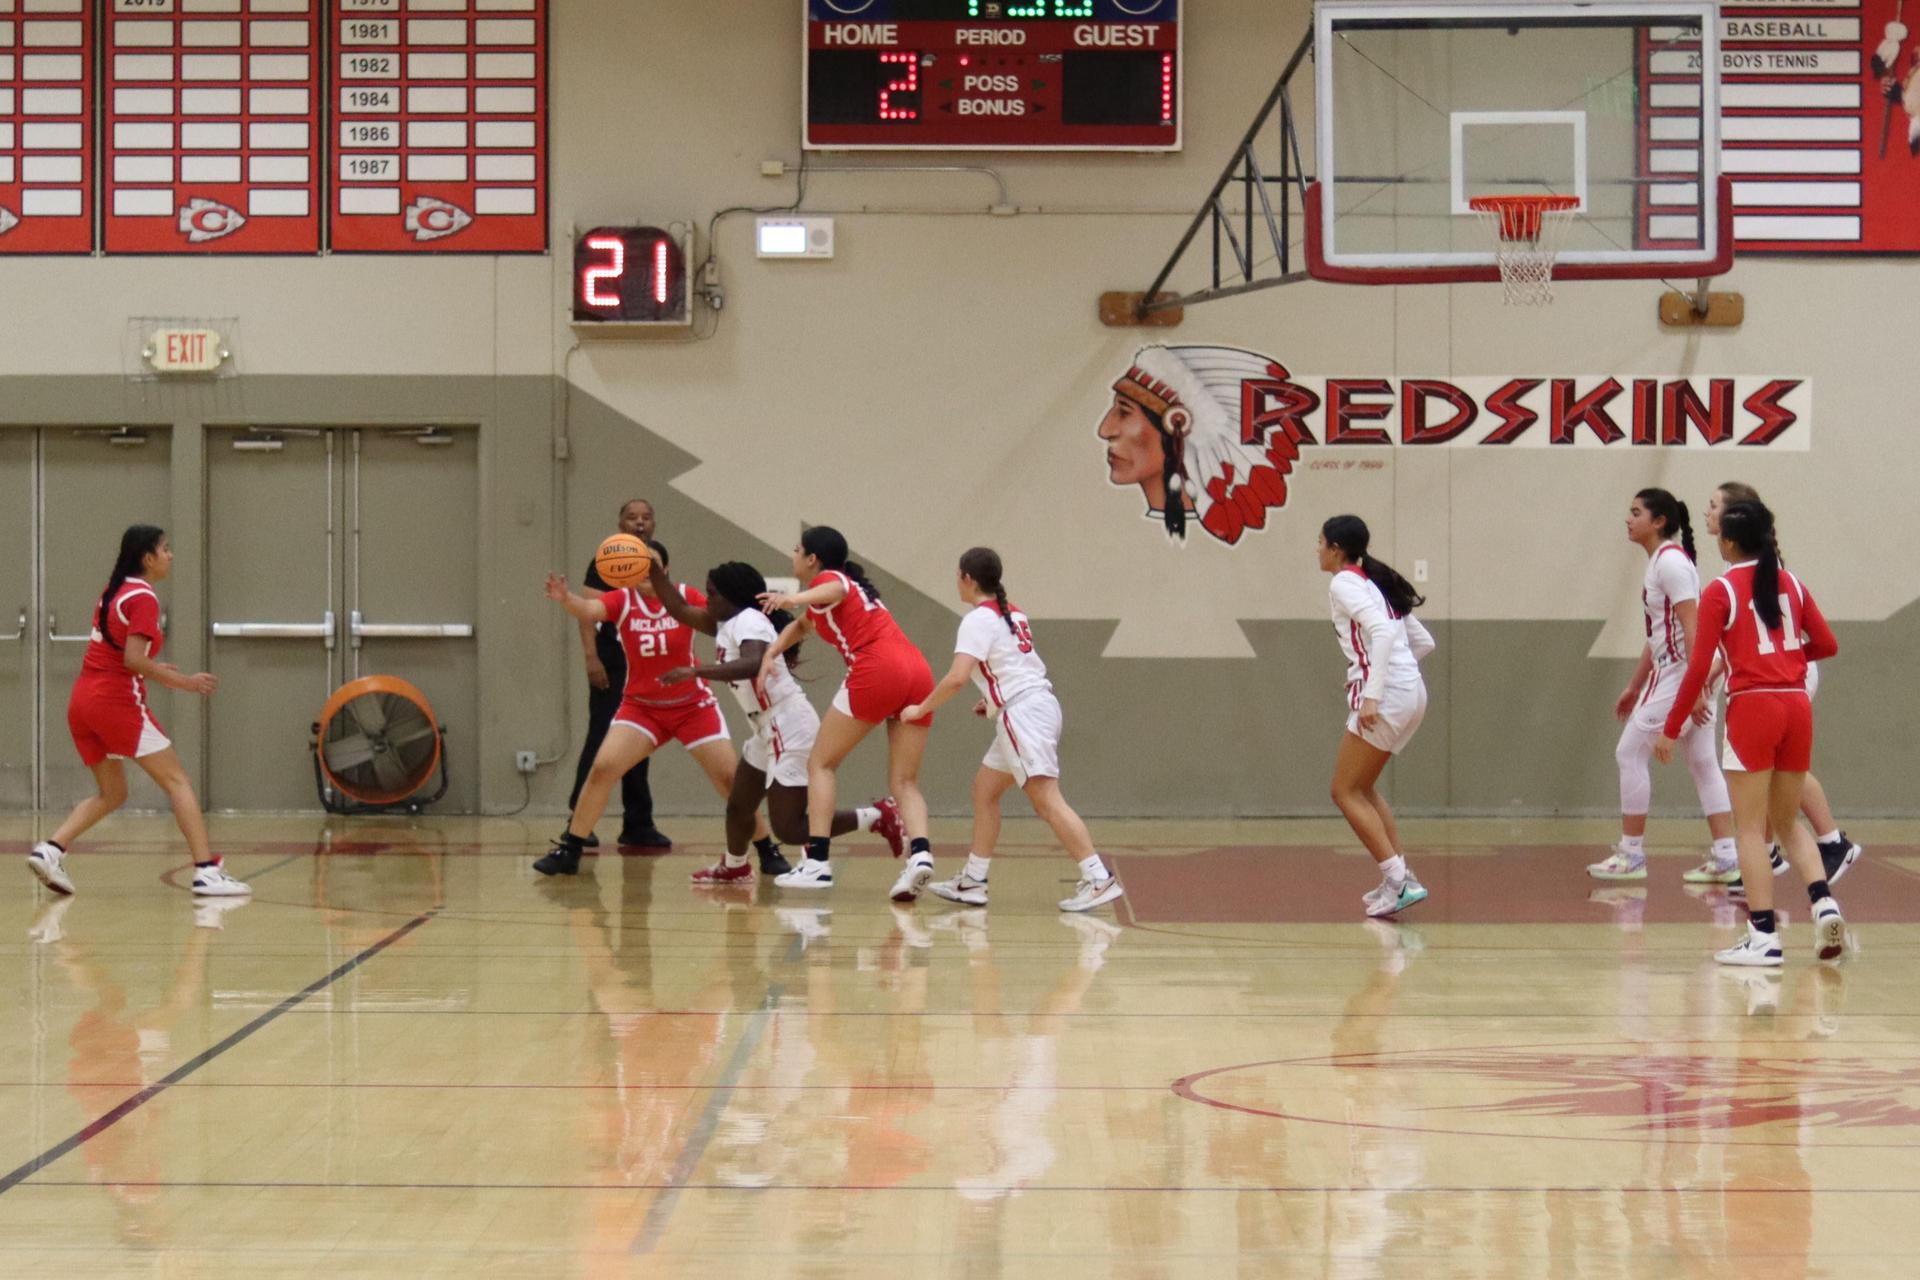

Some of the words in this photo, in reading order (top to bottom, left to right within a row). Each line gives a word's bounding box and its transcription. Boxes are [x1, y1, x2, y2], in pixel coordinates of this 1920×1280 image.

[350, 24, 388, 38] 1981
[824, 24, 899, 45] HOME
[955, 29, 1027, 45] PERIOD
[1073, 24, 1160, 46] GUEST
[1727, 22, 1828, 37] BASEBALL
[350, 58, 390, 72] 1982
[1723, 54, 1763, 68] BOYS
[1769, 54, 1819, 68] TENNIS
[880, 53, 918, 120] 2
[964, 75, 1019, 92] POSS
[1162, 55, 1172, 120] 1
[350, 92, 390, 106] 1984
[958, 99, 1026, 115] BONUS
[350, 127, 390, 141] 1986
[350, 160, 390, 174] 1987
[585, 238, 667, 306] 21
[167, 333, 208, 363] EXIT
[1240, 377, 1804, 445] REDSKINS
[1748, 593, 1801, 655] 11
[640, 632, 668, 657] 21
